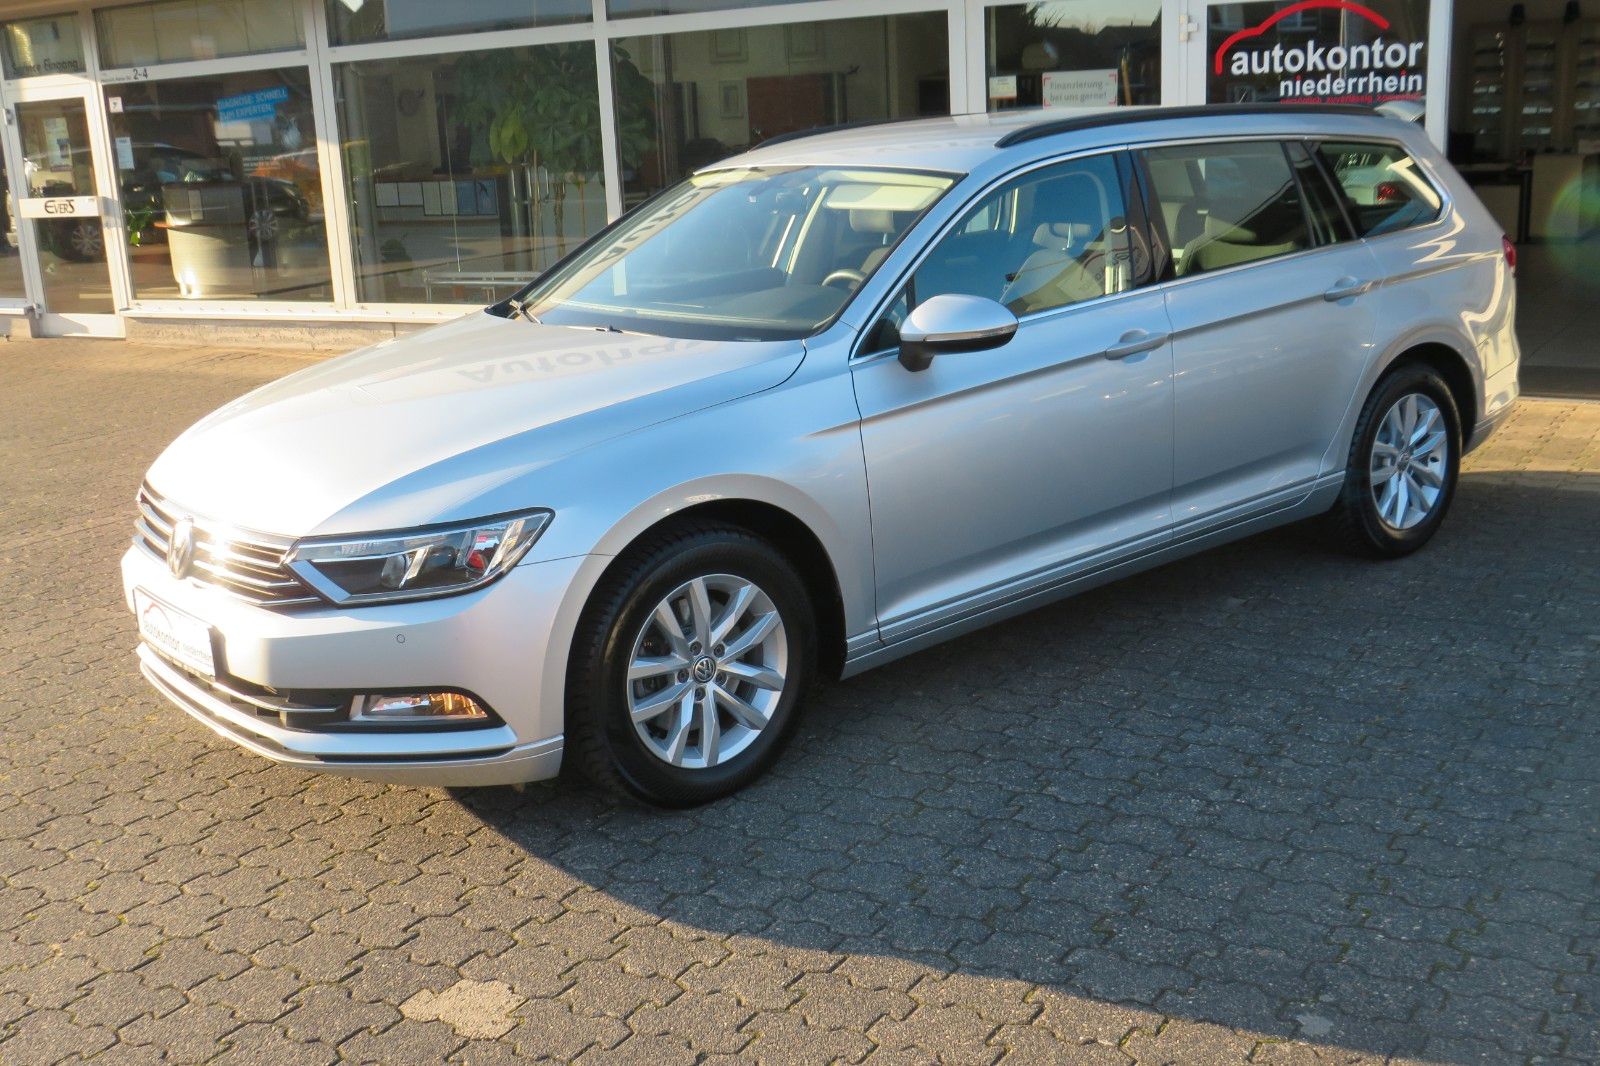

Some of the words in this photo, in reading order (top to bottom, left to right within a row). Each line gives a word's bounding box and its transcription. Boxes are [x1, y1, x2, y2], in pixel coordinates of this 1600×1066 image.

[1230, 37, 1424, 76] autokontor
[43, 58, 79, 72] Eingang
[133, 68, 148, 80] 2-4
[1049, 80, 1104, 91] Finanzierung
[1279, 70, 1423, 97] niederrhein
[256, 89, 288, 104] SCHNELL
